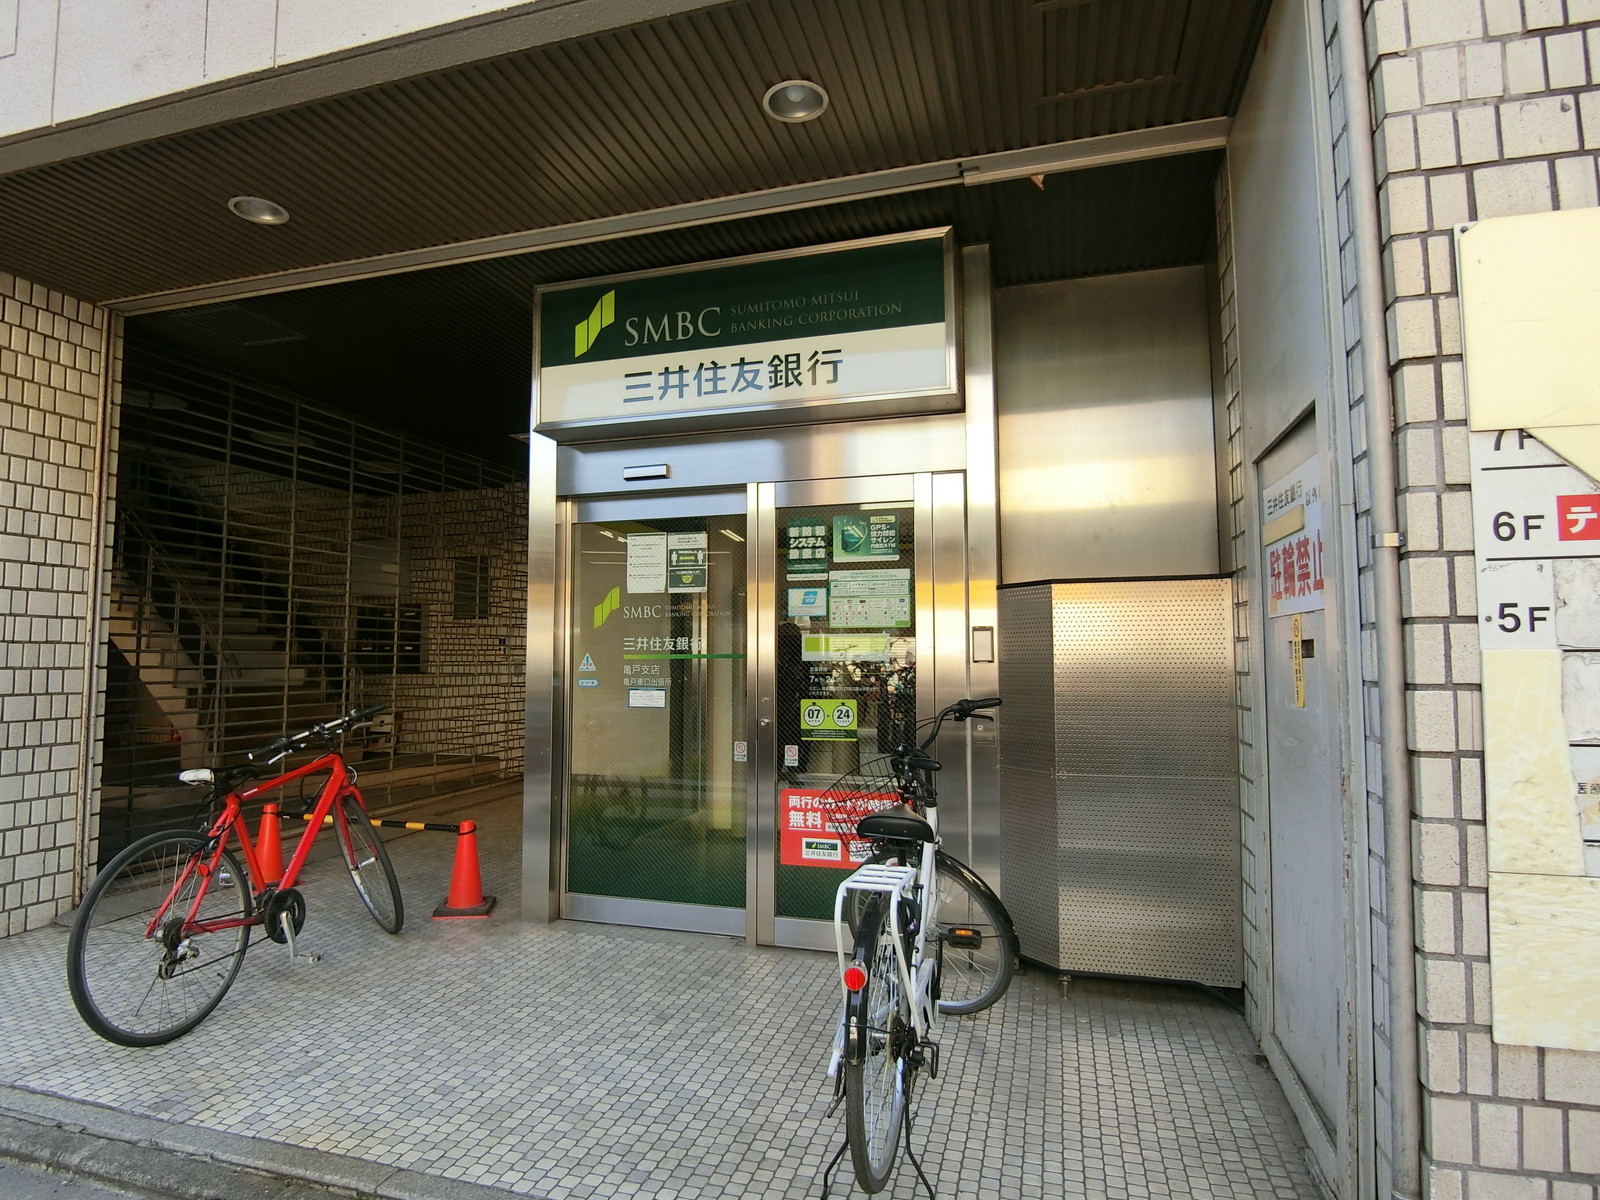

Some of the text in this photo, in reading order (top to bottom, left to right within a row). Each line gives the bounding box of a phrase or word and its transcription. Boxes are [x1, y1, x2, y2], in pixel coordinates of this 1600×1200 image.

[730, 289, 859, 316] SUMITOMO MITSUI
[624, 306, 721, 347] SMBC
[730, 302, 902, 334] BANKING CORPORATION
[623, 348, 843, 404] 三井住友銀行
[1266, 479, 1303, 516] 三井住友銀行
[1492, 511, 1545, 542] 6F
[1567, 506, 1598, 534] テ
[789, 537, 826, 548] システム
[1269, 528, 1324, 601] 駐輪禁止
[623, 605, 662, 619] SMBC
[1497, 602, 1551, 633] 5F
[623, 636, 703, 651] 三井住友銀行
[623, 664, 660, 675] 亀戸支店
[623, 677, 672, 687] 亀戸東口出張所
[807, 708, 821, 719] 07
[836, 708, 851, 719] 24
[788, 810, 822, 828] 無料
